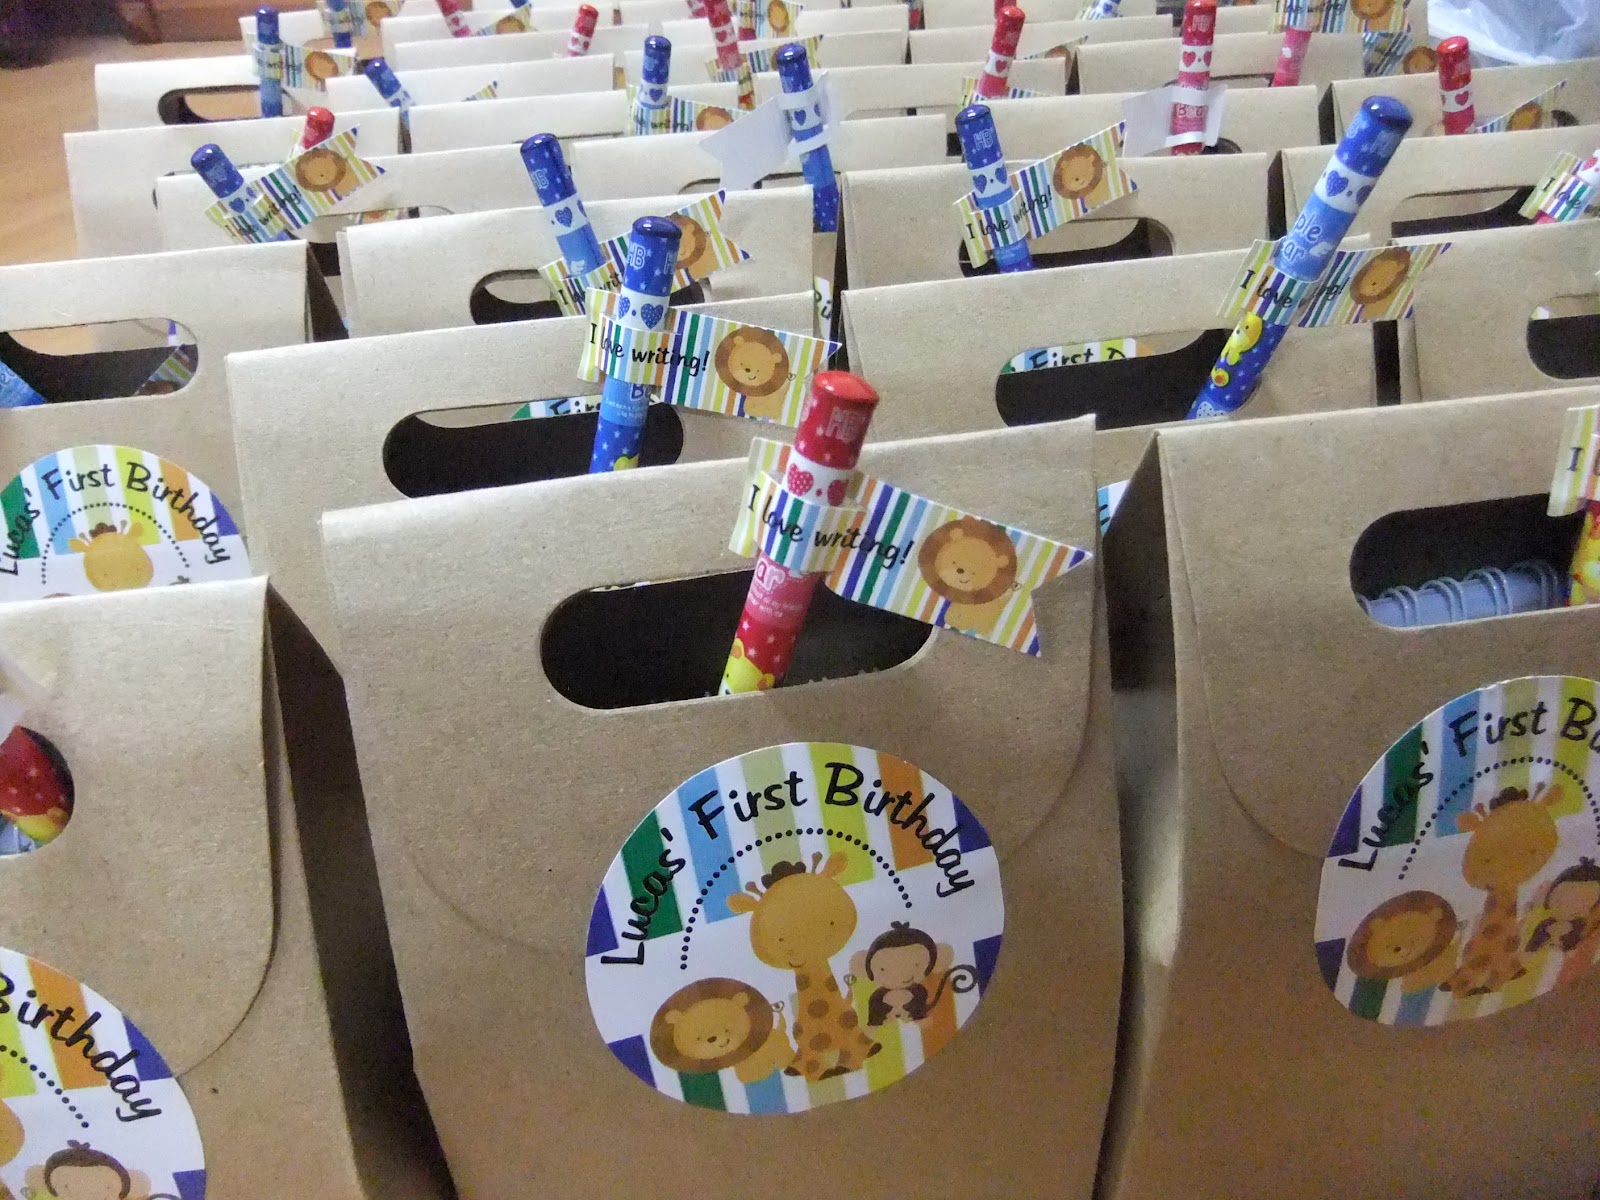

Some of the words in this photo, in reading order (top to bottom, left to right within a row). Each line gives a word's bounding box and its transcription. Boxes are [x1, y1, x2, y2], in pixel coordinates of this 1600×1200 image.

[965, 222, 976, 240] I
[978, 218, 1011, 237] love
[1256, 276, 1294, 309] love
[589, 322, 598, 345] I
[600, 326, 625, 358] love
[631, 347, 711, 377] writing!
[0, 487, 41, 577] Lucas'
[41, 463, 116, 501] First
[125, 461, 231, 564] Birthday
[748, 483, 760, 512] I
[762, 495, 804, 542] love
[814, 527, 915, 570] writing!
[1337, 740, 1434, 872] Lucas'
[1449, 701, 1548, 757] First
[600, 827, 686, 966] Lucas'
[687, 770, 808, 840] First
[824, 761, 975, 898] Birthday
